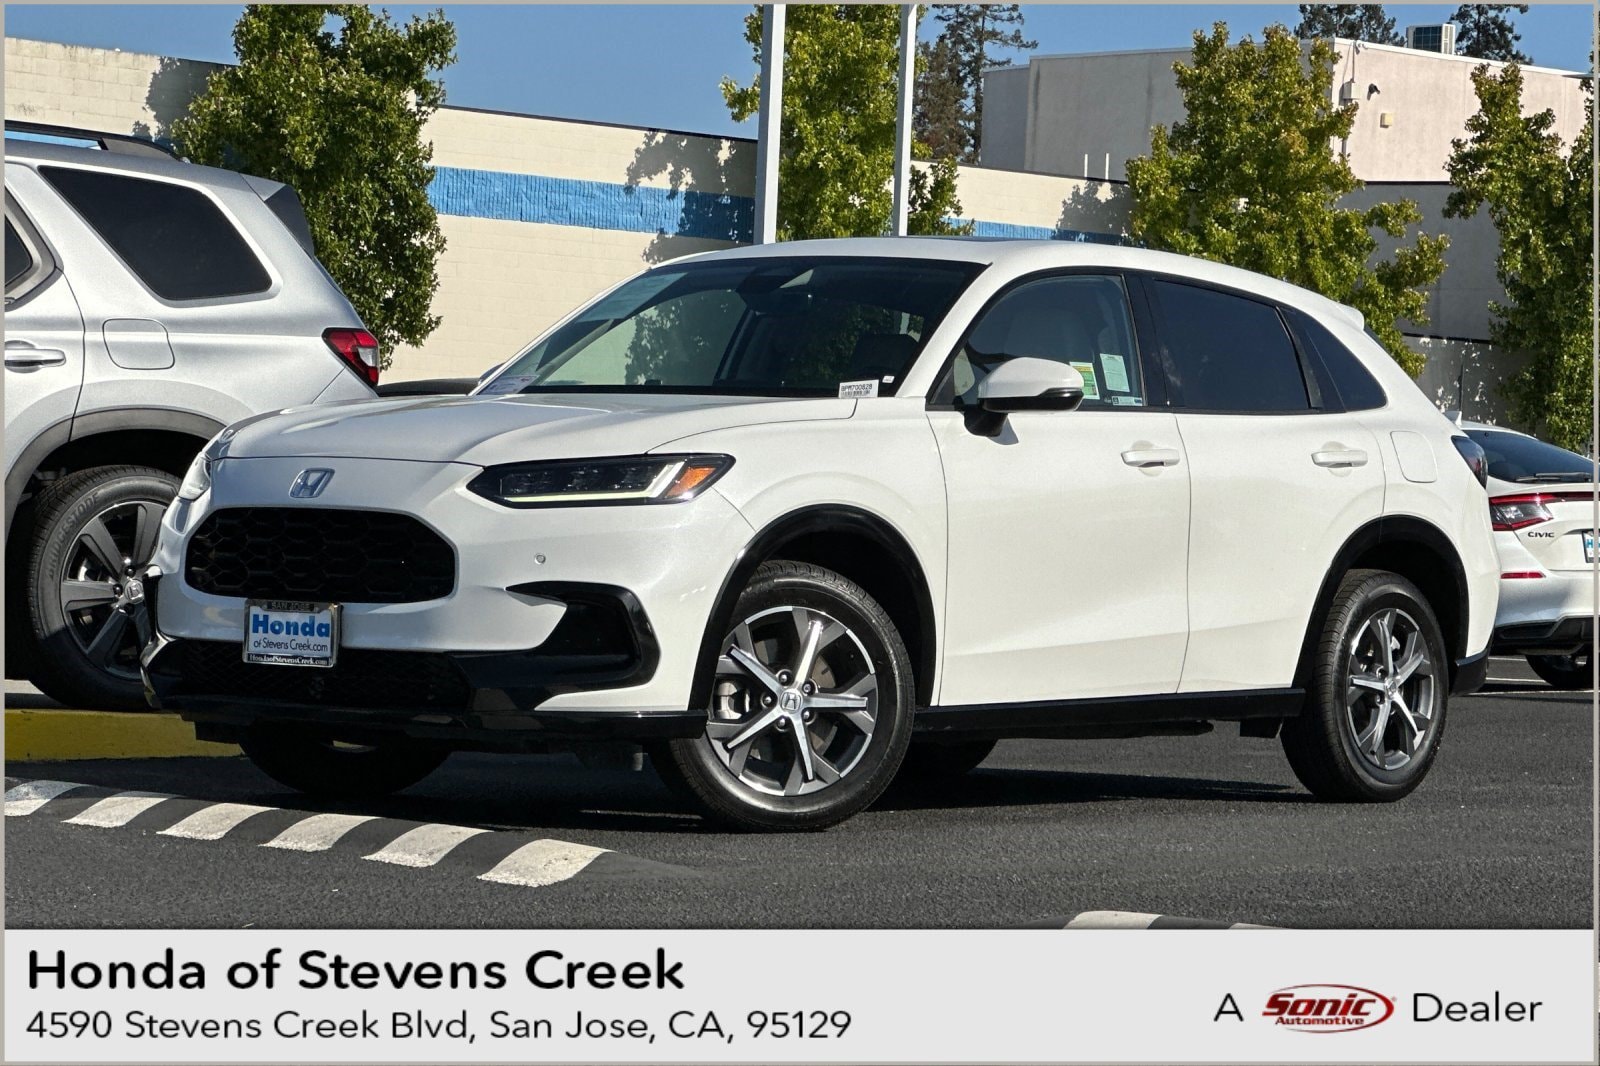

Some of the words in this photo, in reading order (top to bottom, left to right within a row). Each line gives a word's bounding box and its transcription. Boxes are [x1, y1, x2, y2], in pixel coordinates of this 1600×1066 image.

[252, 614, 331, 638] Honda
[253, 639, 261, 648] of
[262, 638, 289, 650] Stevens
[290, 639, 328, 652] Creek.com
